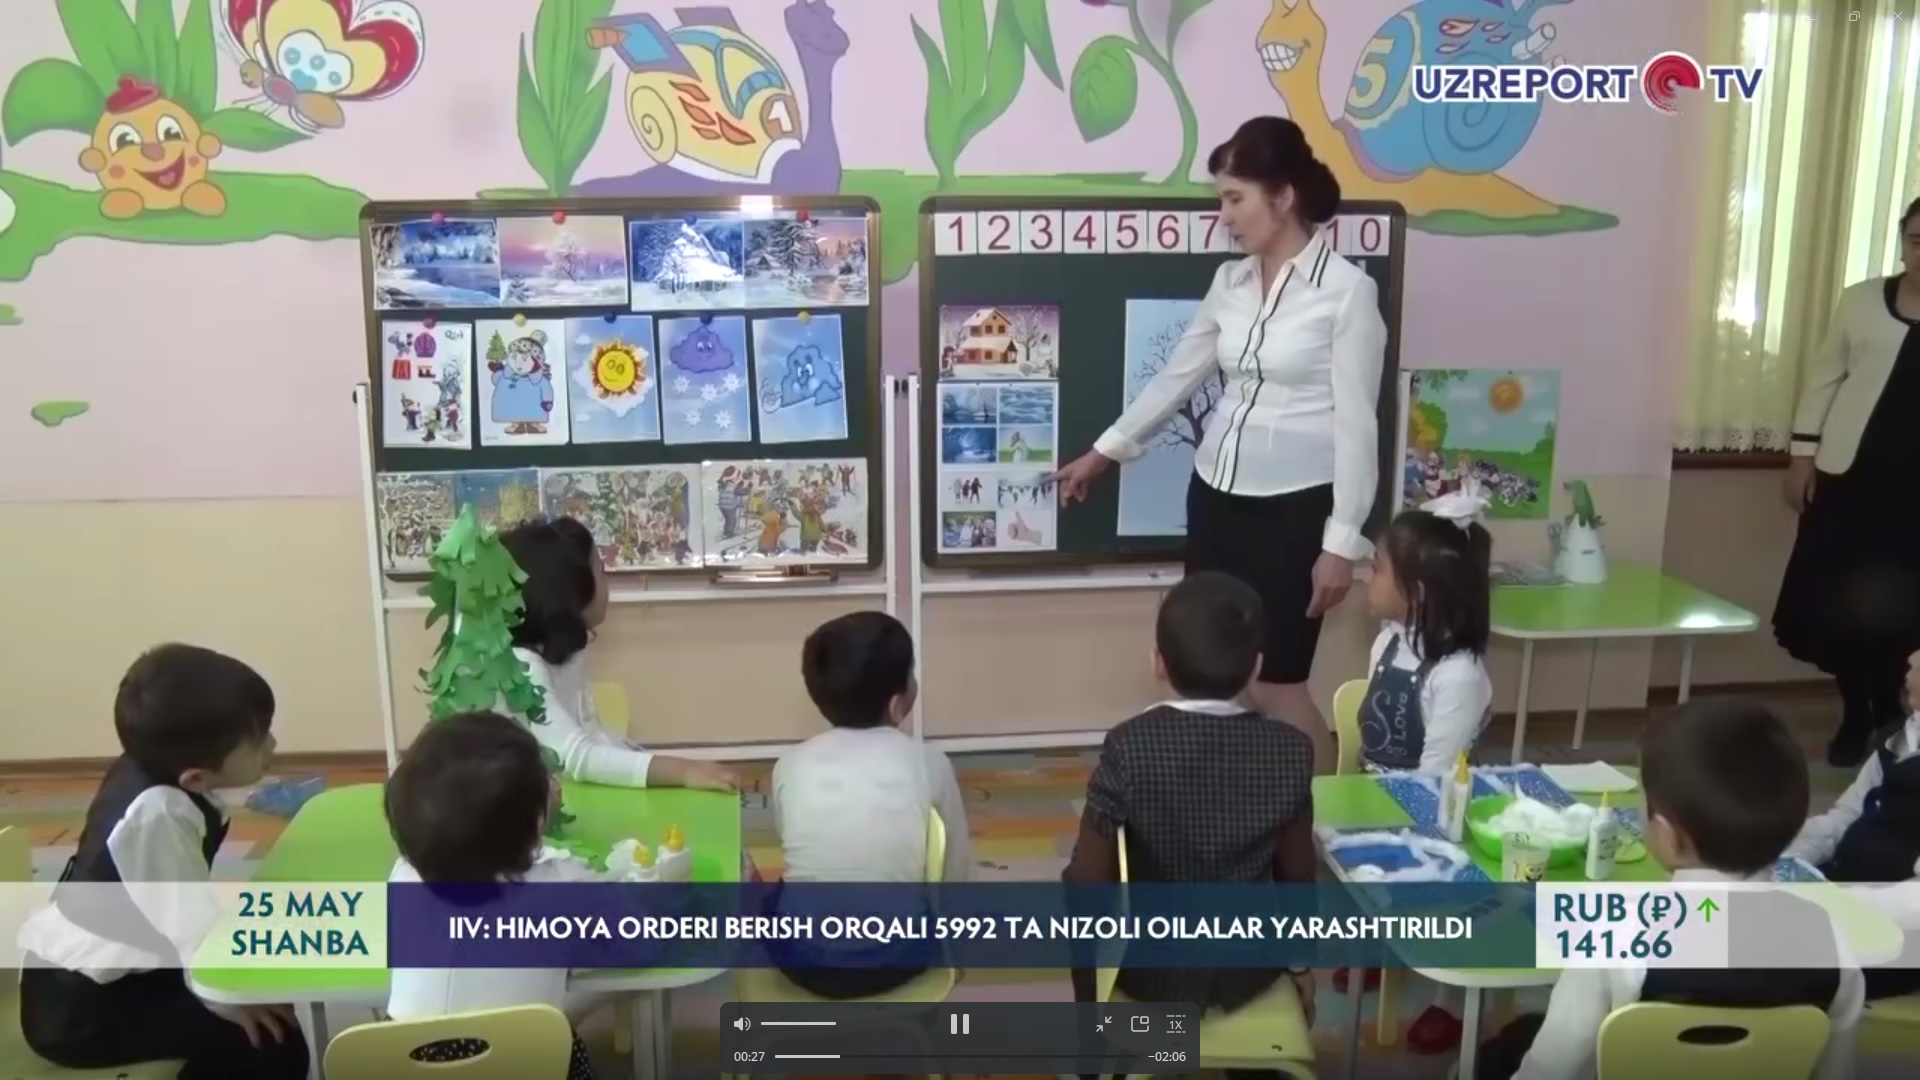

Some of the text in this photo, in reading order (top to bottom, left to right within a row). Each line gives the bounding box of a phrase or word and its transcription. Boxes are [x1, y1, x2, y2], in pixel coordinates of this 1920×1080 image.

[1347, 38, 1395, 108] 5
[768, 100, 793, 132] 1
[949, 216, 965, 251] 1
[988, 215, 1011, 250] 2
[1030, 215, 1053, 249] 3
[1072, 215, 1096, 249] 4
[1116, 214, 1139, 249] 5
[1157, 214, 1180, 250] 6
[1198, 215, 1220, 250] 7
